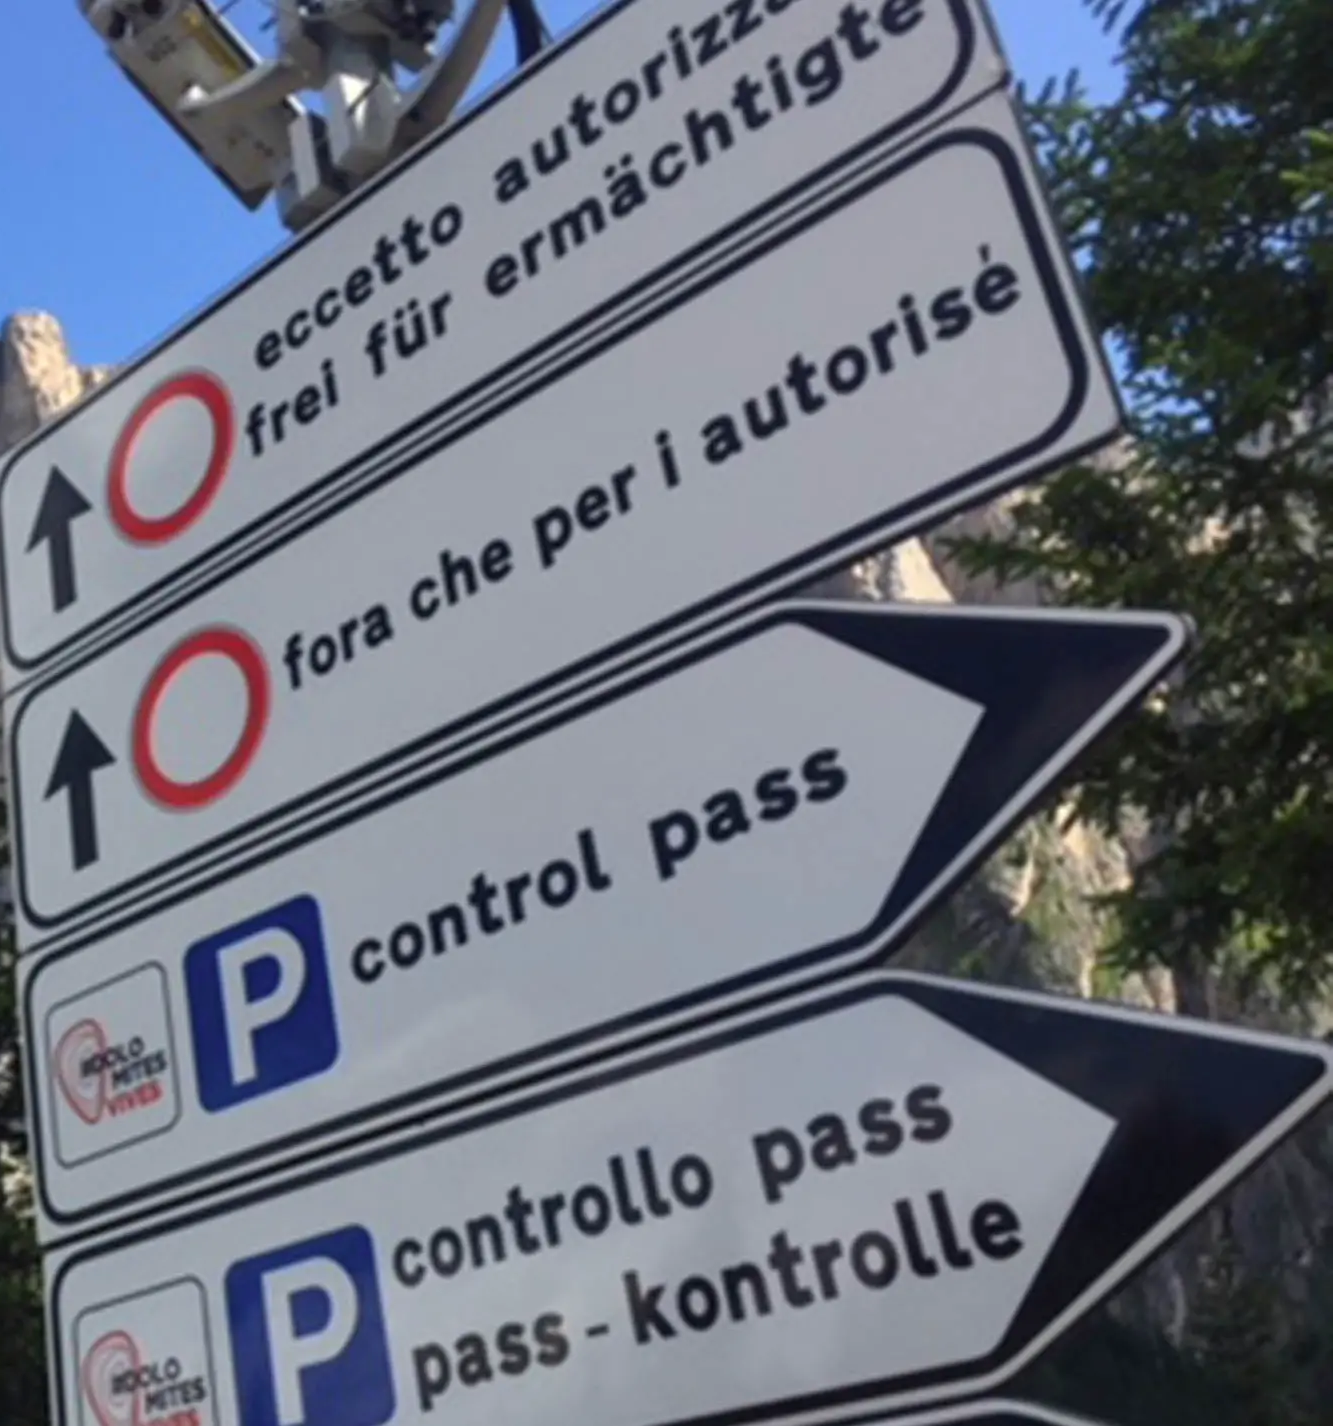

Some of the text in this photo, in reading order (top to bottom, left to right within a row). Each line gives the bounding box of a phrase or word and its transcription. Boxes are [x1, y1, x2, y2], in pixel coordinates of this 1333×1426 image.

[244, 0, 926, 458] frei für ermächtigte
[253, 203, 464, 371] eccetto
[281, 243, 1021, 692] fora che per i autorisé
[350, 747, 849, 985] control pass
[218, 928, 306, 1086] P
[392, 1084, 953, 1288] controllo pass
[261, 1256, 358, 1425] P
[412, 1312, 570, 1413] pass
[623, 1188, 1025, 1346] kontrolle
